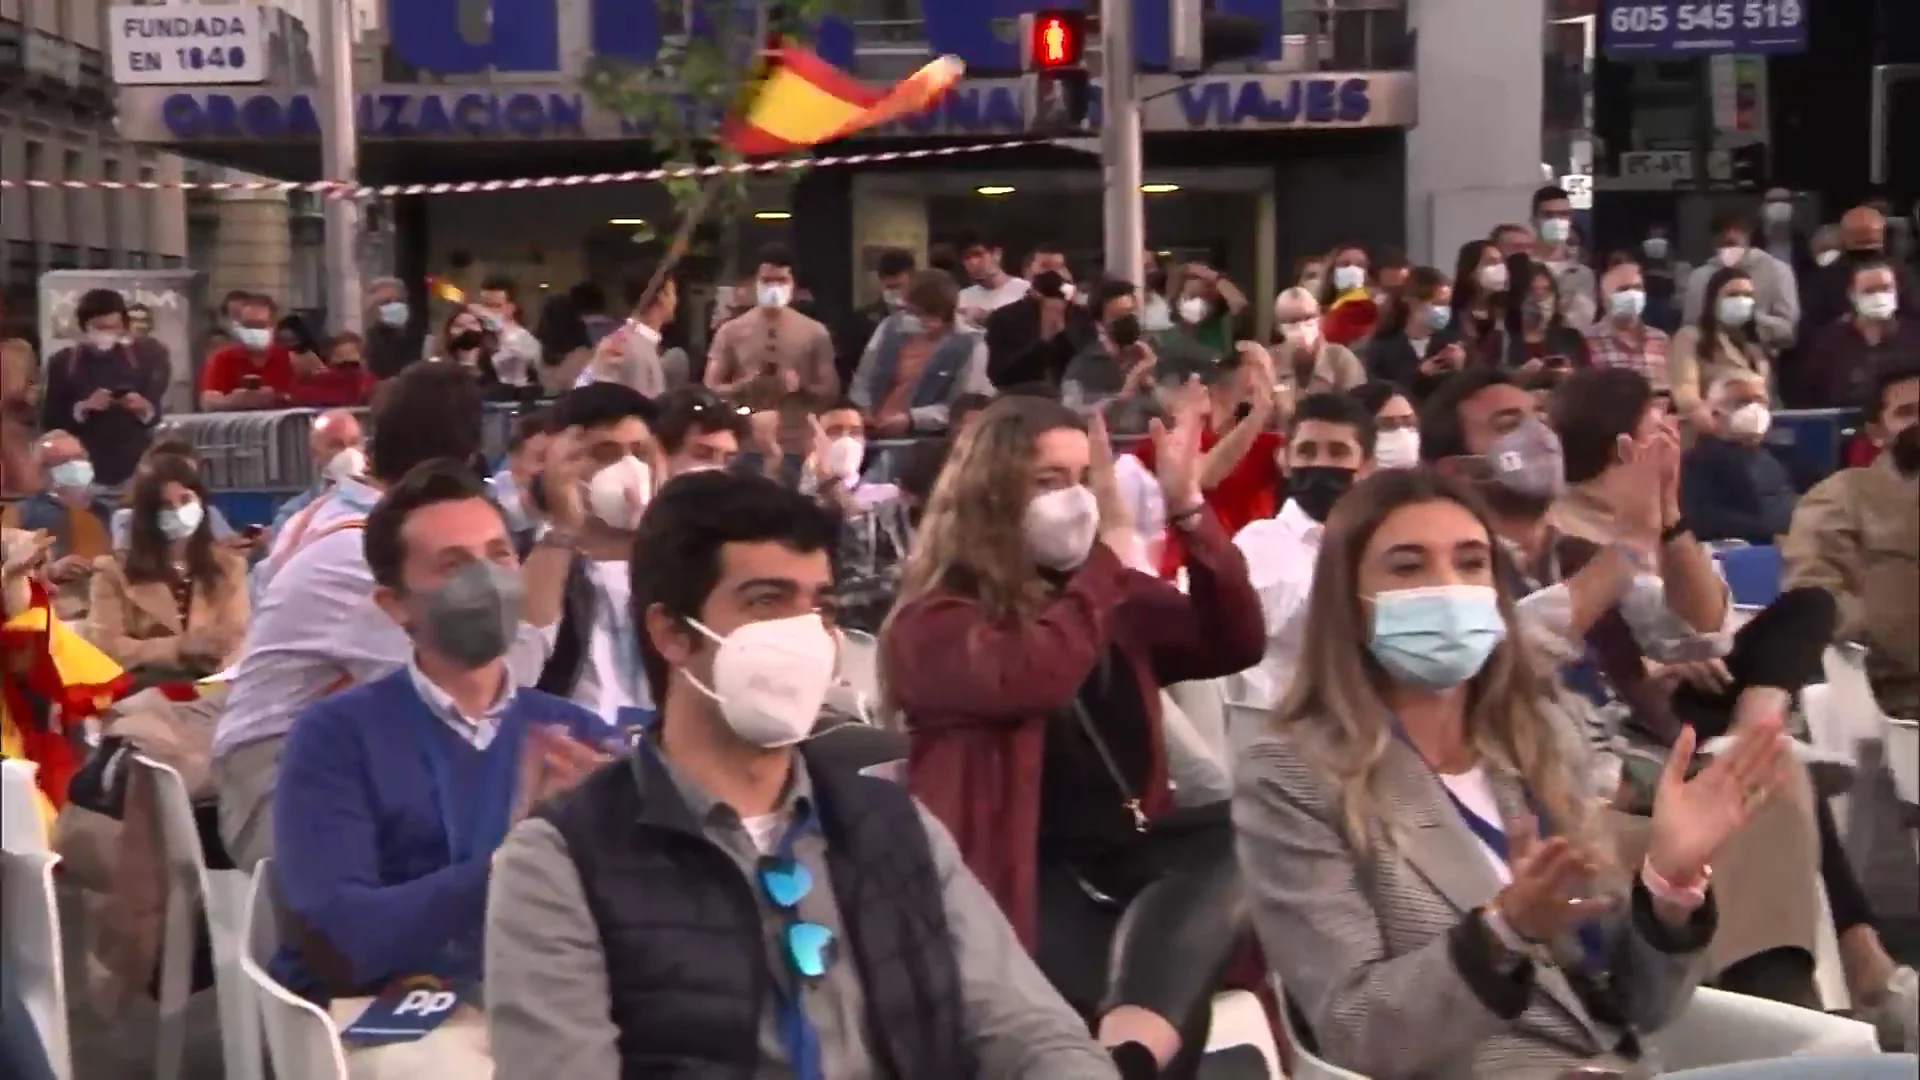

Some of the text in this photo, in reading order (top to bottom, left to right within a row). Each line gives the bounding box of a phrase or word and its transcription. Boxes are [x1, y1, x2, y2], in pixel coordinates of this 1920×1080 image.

[124, 16, 246, 38] FUNDADA
[1610, 1, 1801, 32] 605 545 519
[129, 51, 162, 71] EN
[162, 92, 588, 140] ORGAIZACION
[1176, 79, 1371, 128] VIAJES
